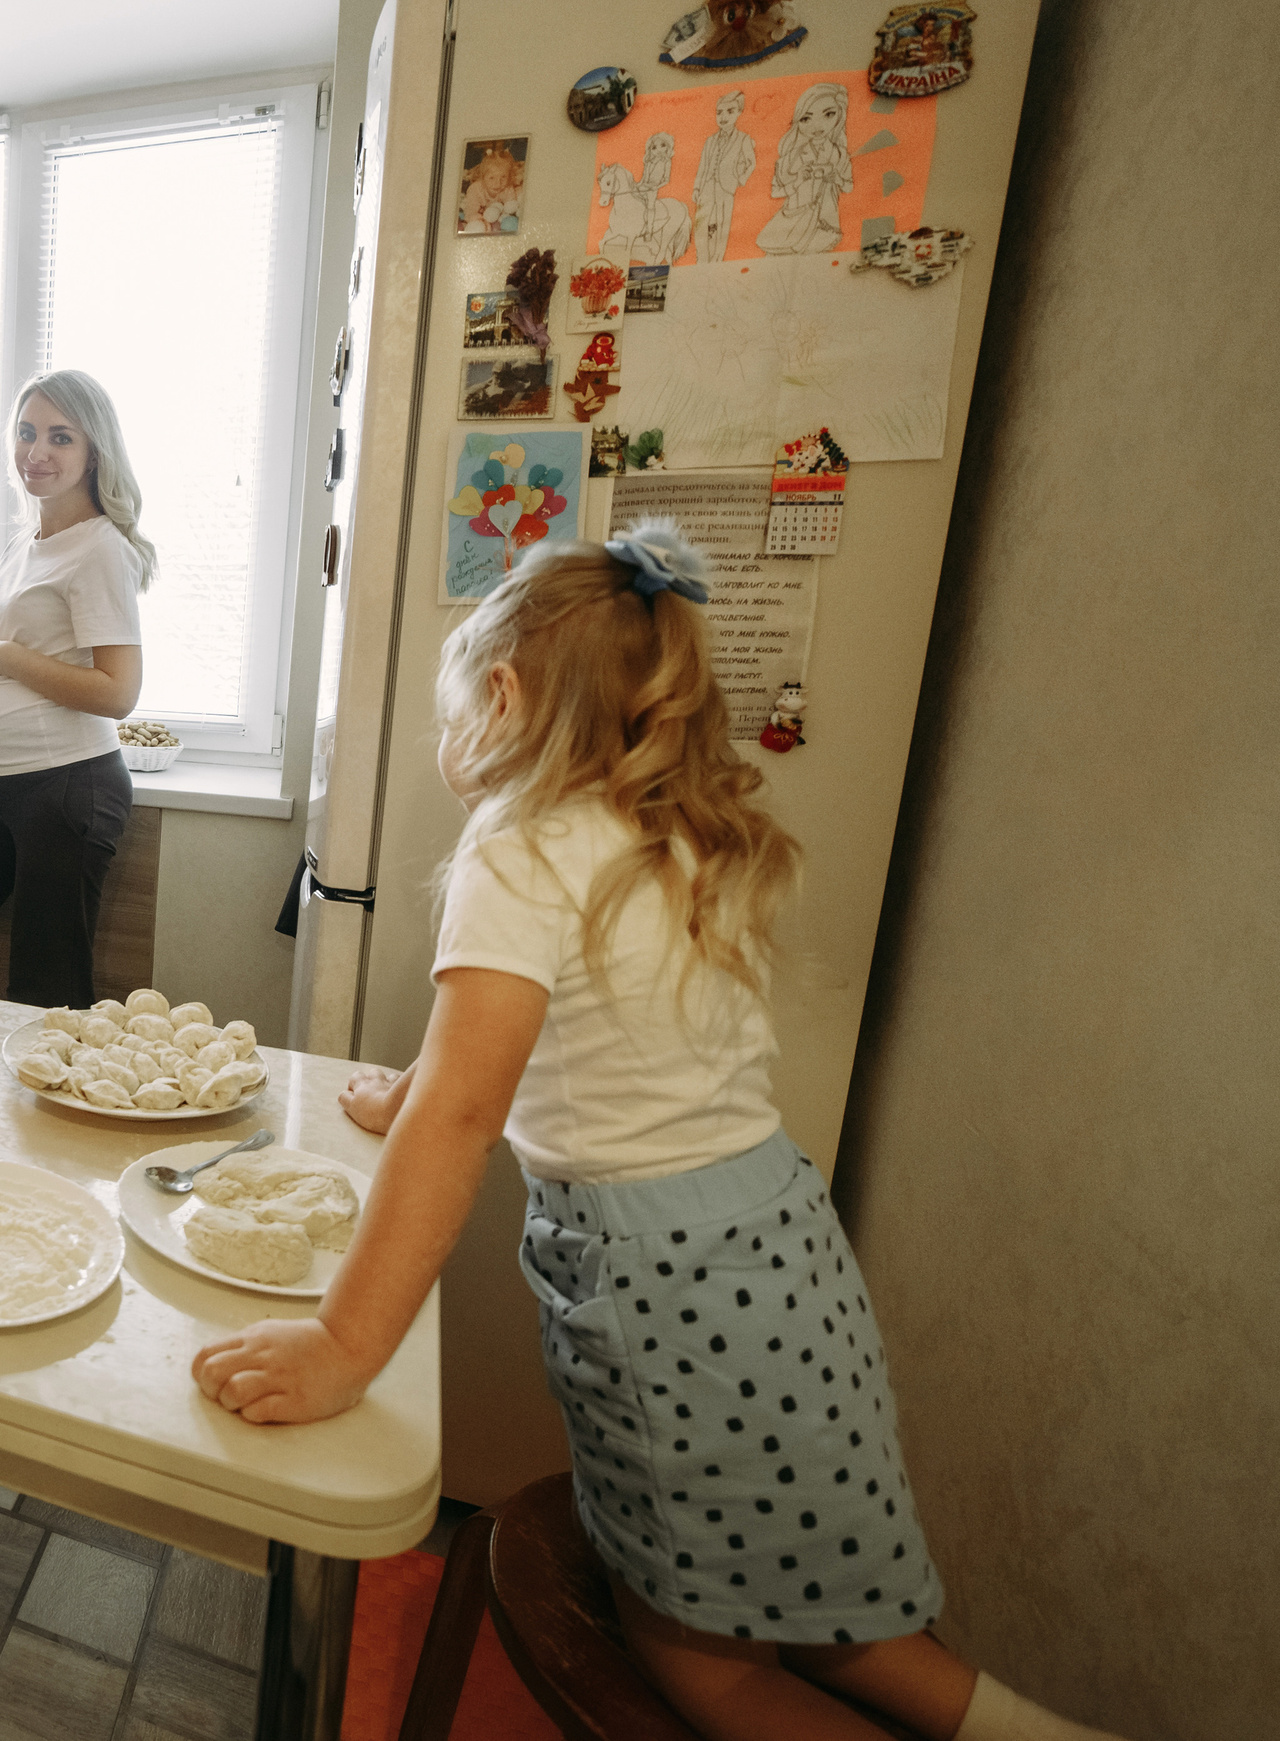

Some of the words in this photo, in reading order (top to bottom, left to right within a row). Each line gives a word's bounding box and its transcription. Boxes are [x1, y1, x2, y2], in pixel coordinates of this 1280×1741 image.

[624, 485, 655, 495] начала
[656, 482, 736, 494] сосредоточьтесь
[738, 482, 749, 491] на
[786, 493, 817, 502] НОЯБРЬ
[612, 499, 655, 511] уживаете
[657, 494, 703, 507] хороший
[463, 540, 474, 553] С
[705, 552, 751, 560] РИНИМАЮ
[741, 564, 763, 572] ЕСТЬ.
[752, 597, 784, 606] ЖИЗНЬ.
[720, 630, 735, 638] ЧТО
[737, 630, 757, 638] МНЕ
[731, 646, 751, 654] МОЯ
[754, 646, 783, 655] ЖИЗНЬ
